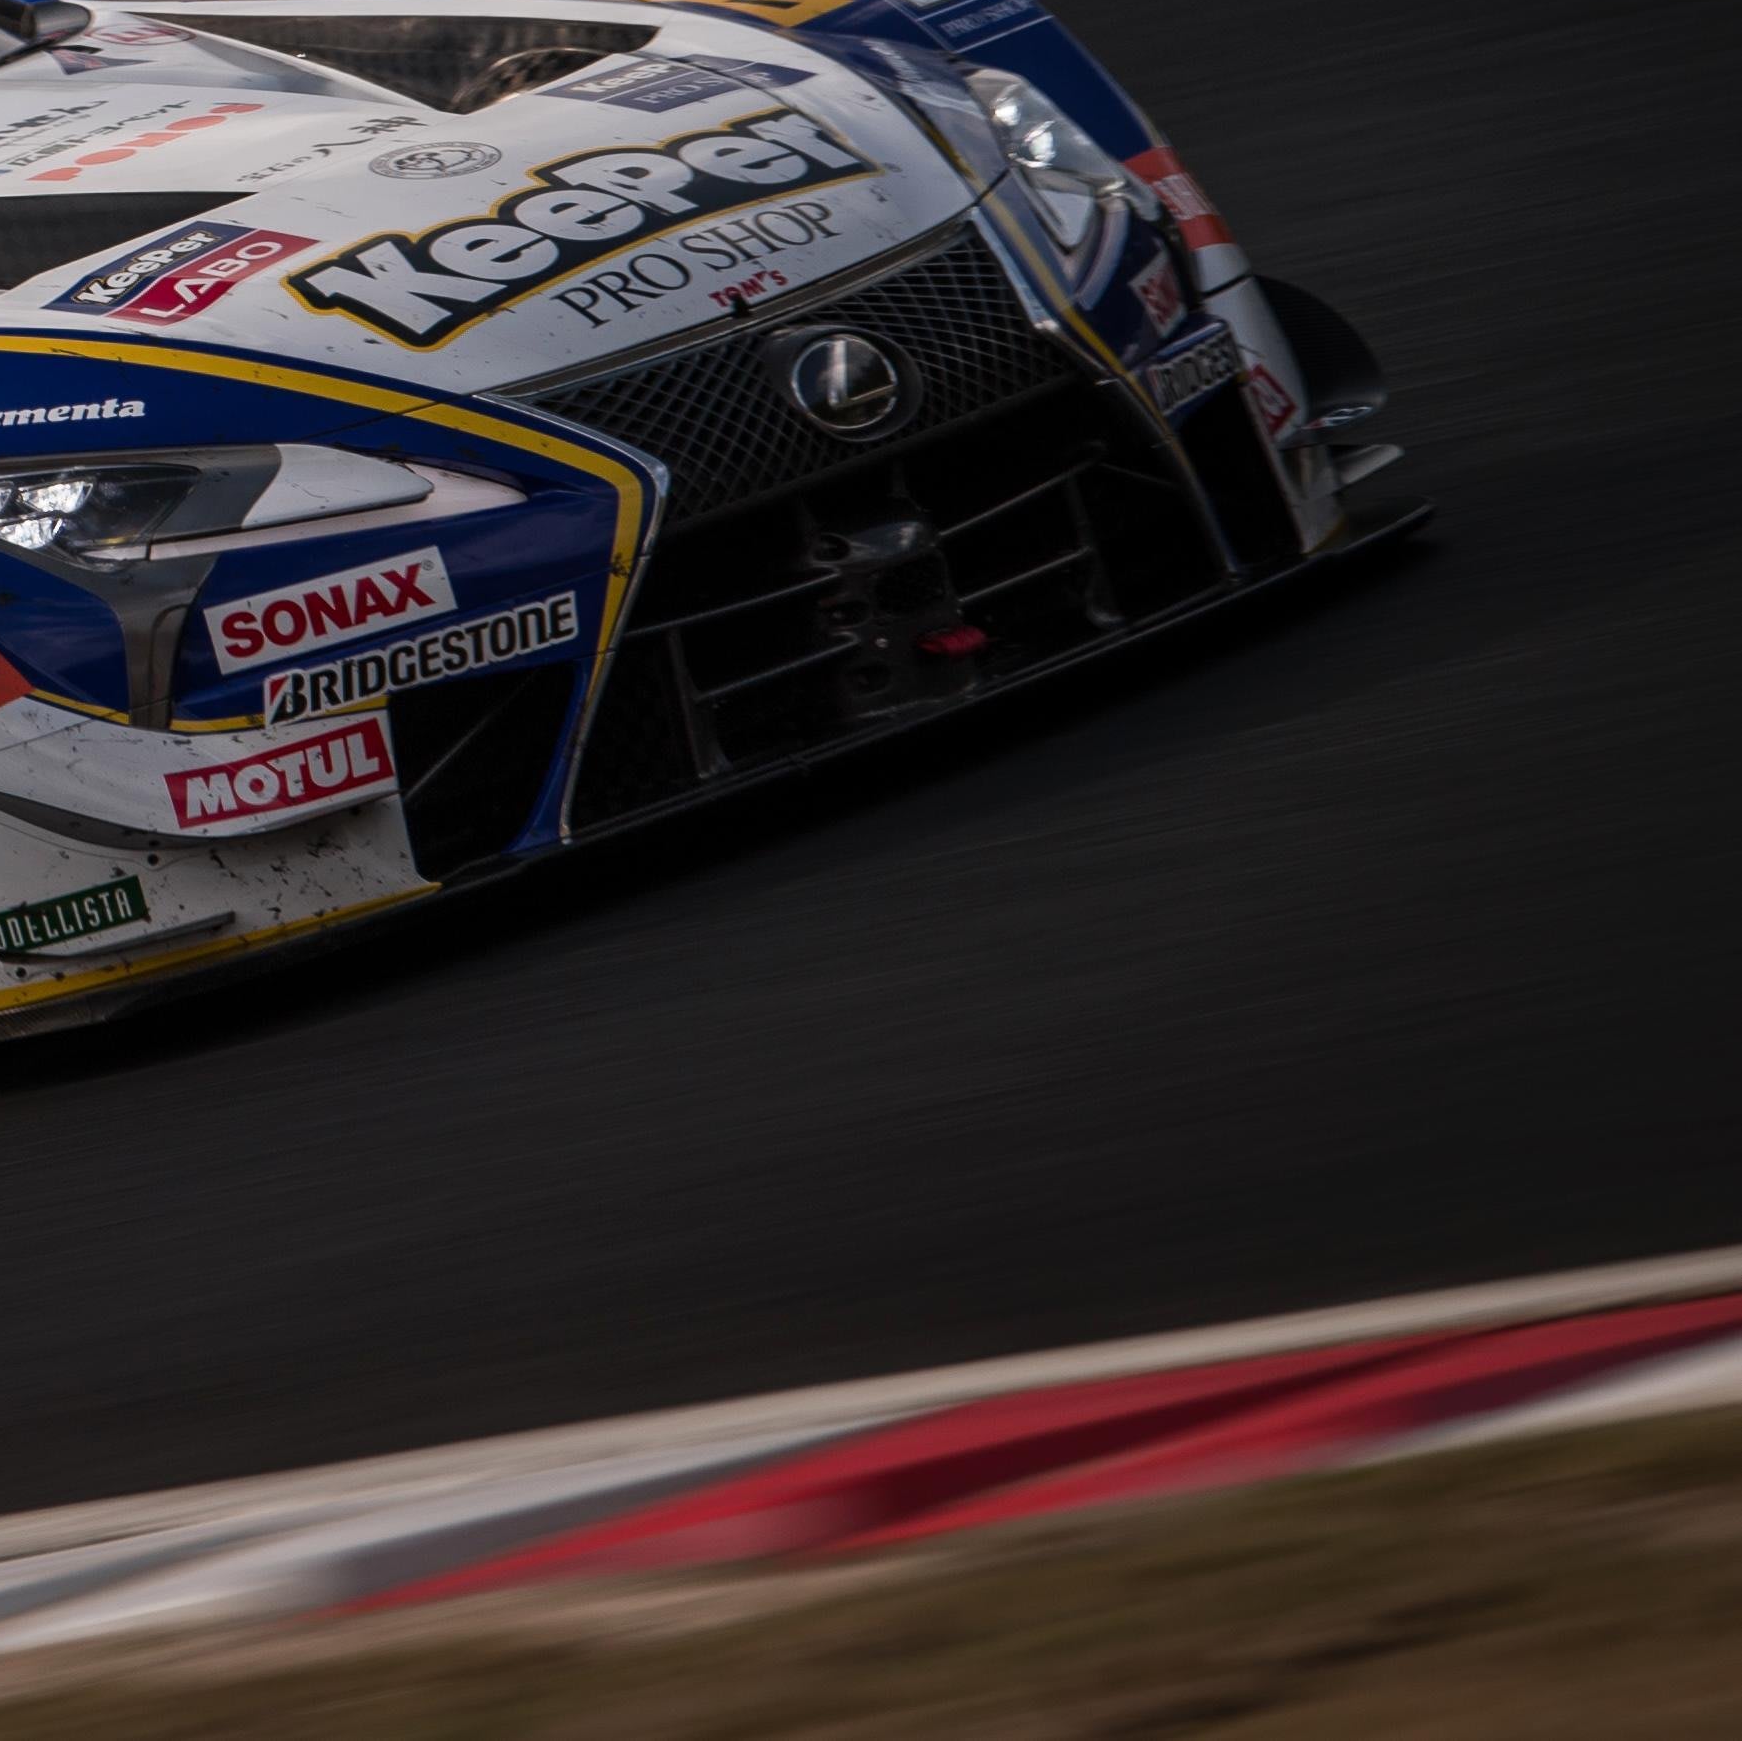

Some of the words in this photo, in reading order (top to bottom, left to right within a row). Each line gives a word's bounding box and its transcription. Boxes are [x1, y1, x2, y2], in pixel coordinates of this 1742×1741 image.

[75, 230, 221, 306] KeePer
[297, 106, 872, 342] KeePer
[550, 253, 692, 329] PRO
[678, 201, 842, 272] SHOP
[138, 239, 285, 320] LABO
[219, 561, 437, 659] SONAX
[269, 594, 577, 724] BRIDGESTONE
[184, 731, 383, 821] MOTUL
